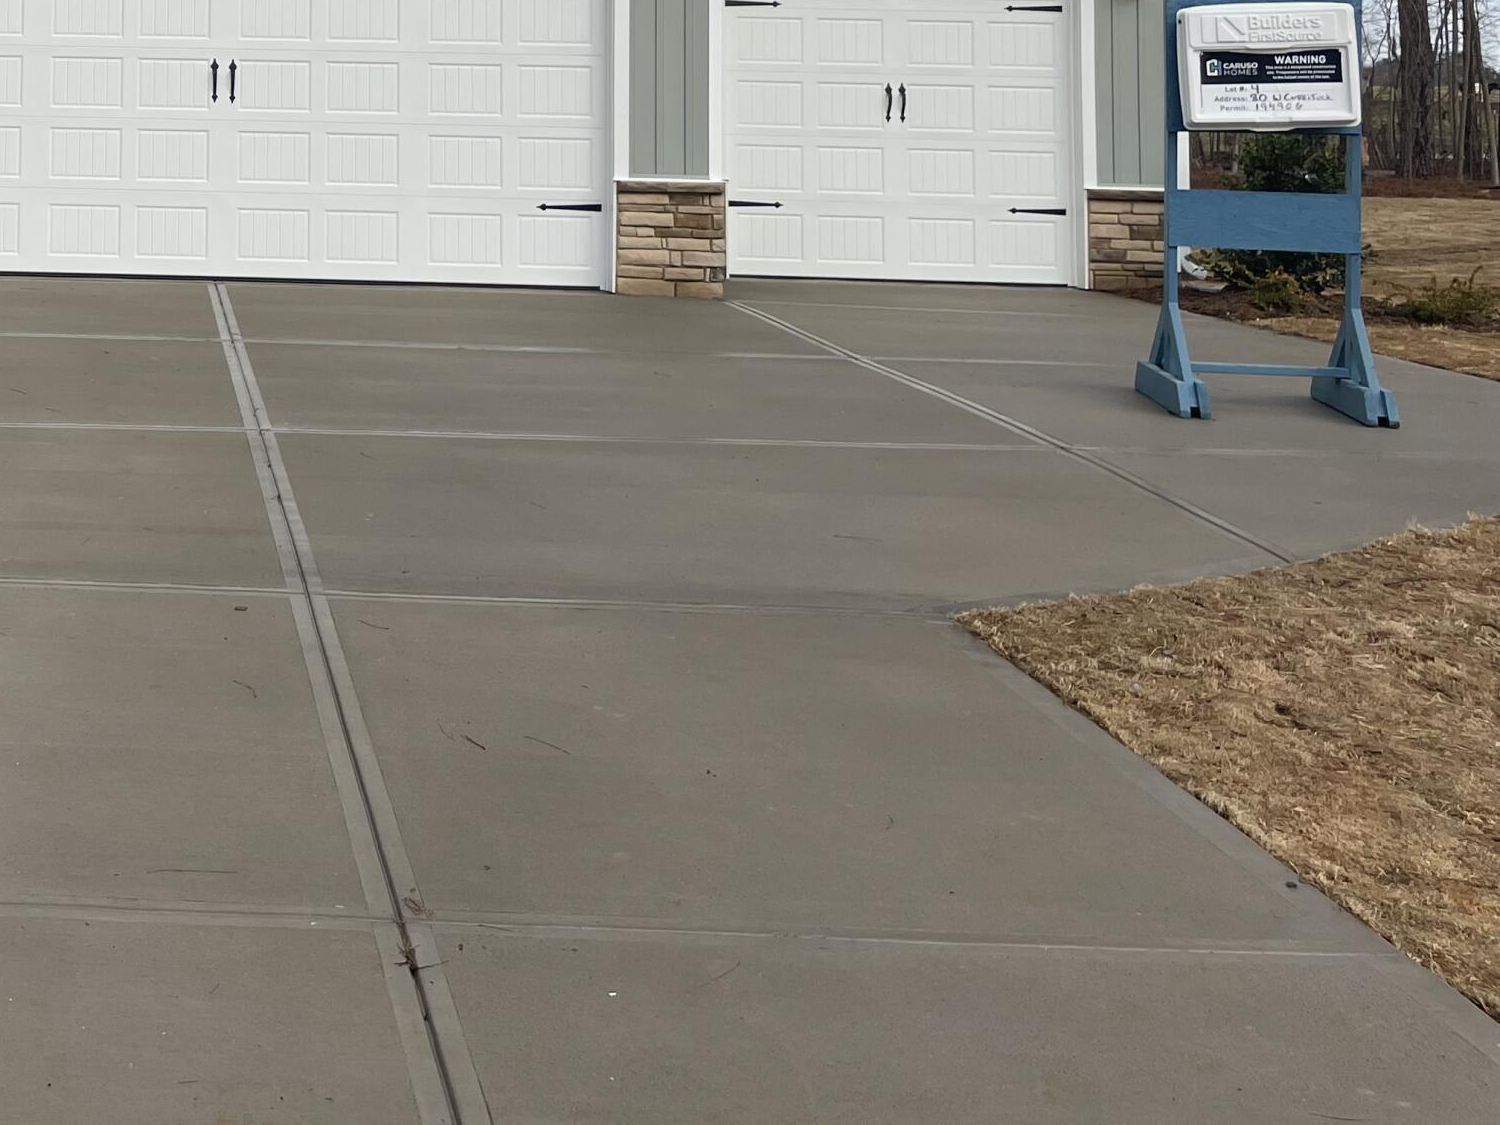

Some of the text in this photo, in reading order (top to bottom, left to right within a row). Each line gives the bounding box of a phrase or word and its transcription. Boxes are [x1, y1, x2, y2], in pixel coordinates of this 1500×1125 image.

[1247, 15, 1323, 30] Builders
[1248, 30, 1323, 43] FirstSource
[1274, 55, 1327, 65] WARNING
[1223, 62, 1258, 70] CARUSO
[1250, 84, 1259, 94] 4
